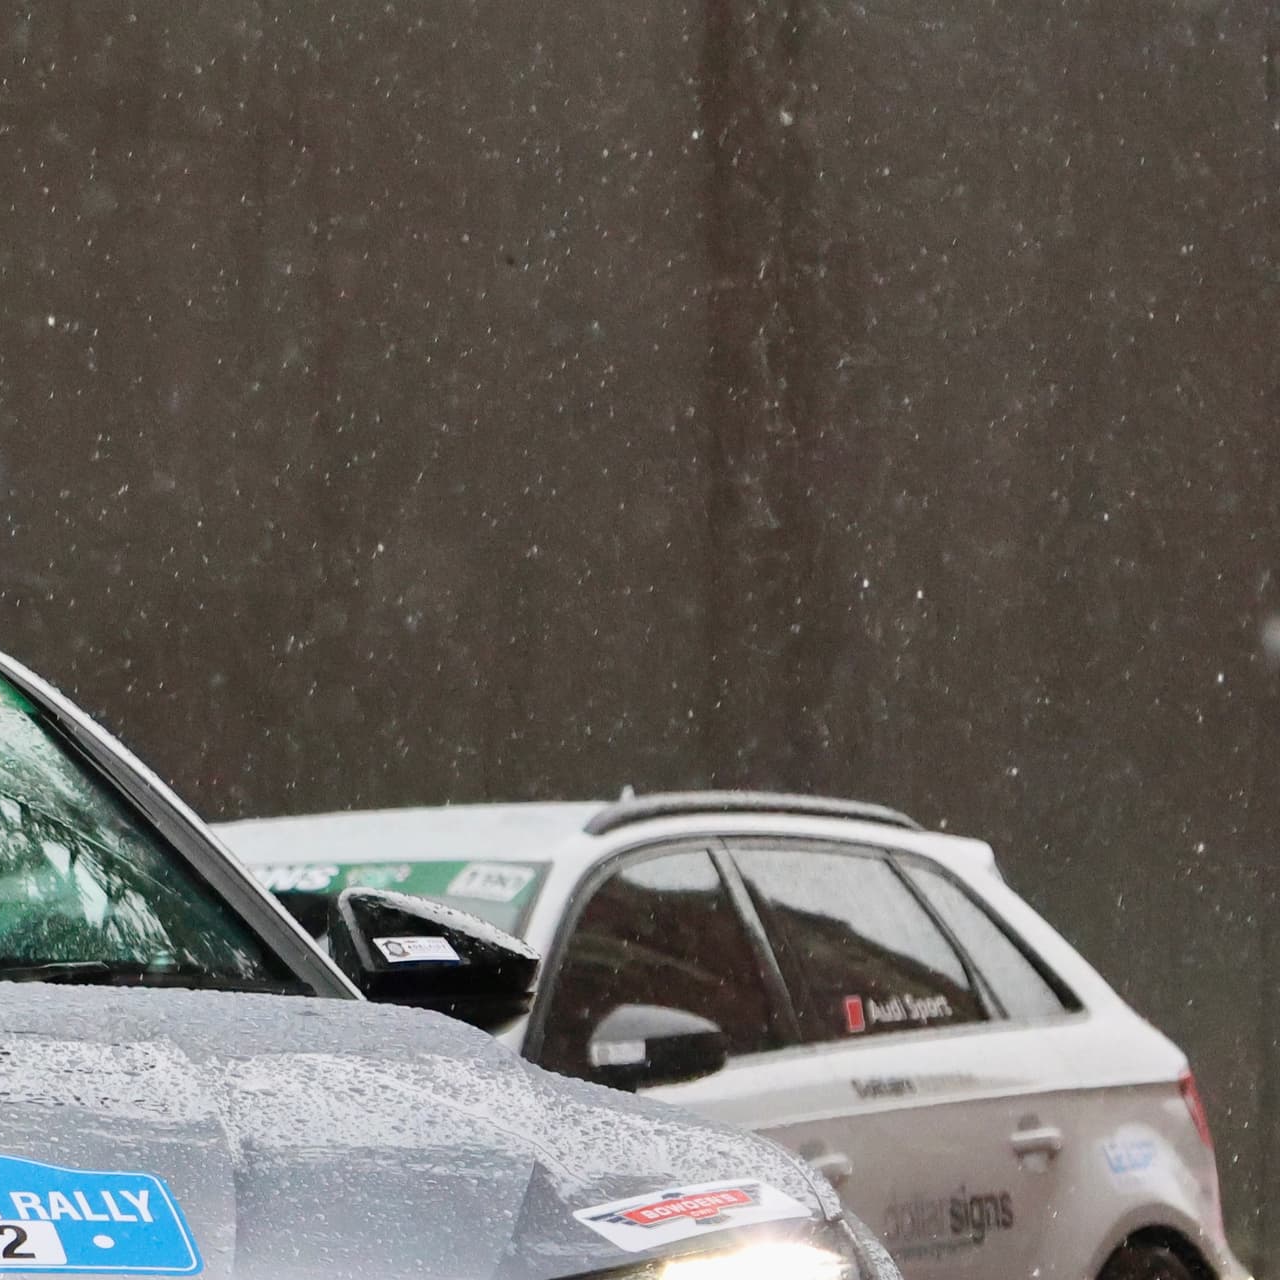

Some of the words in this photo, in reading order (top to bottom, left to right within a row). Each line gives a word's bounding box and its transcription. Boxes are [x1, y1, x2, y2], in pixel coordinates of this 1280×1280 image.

[868, 996, 907, 1023] Audi
[9, 1189, 158, 1223] RALLY
[640, 1192, 738, 1220] BOWDEN'S
